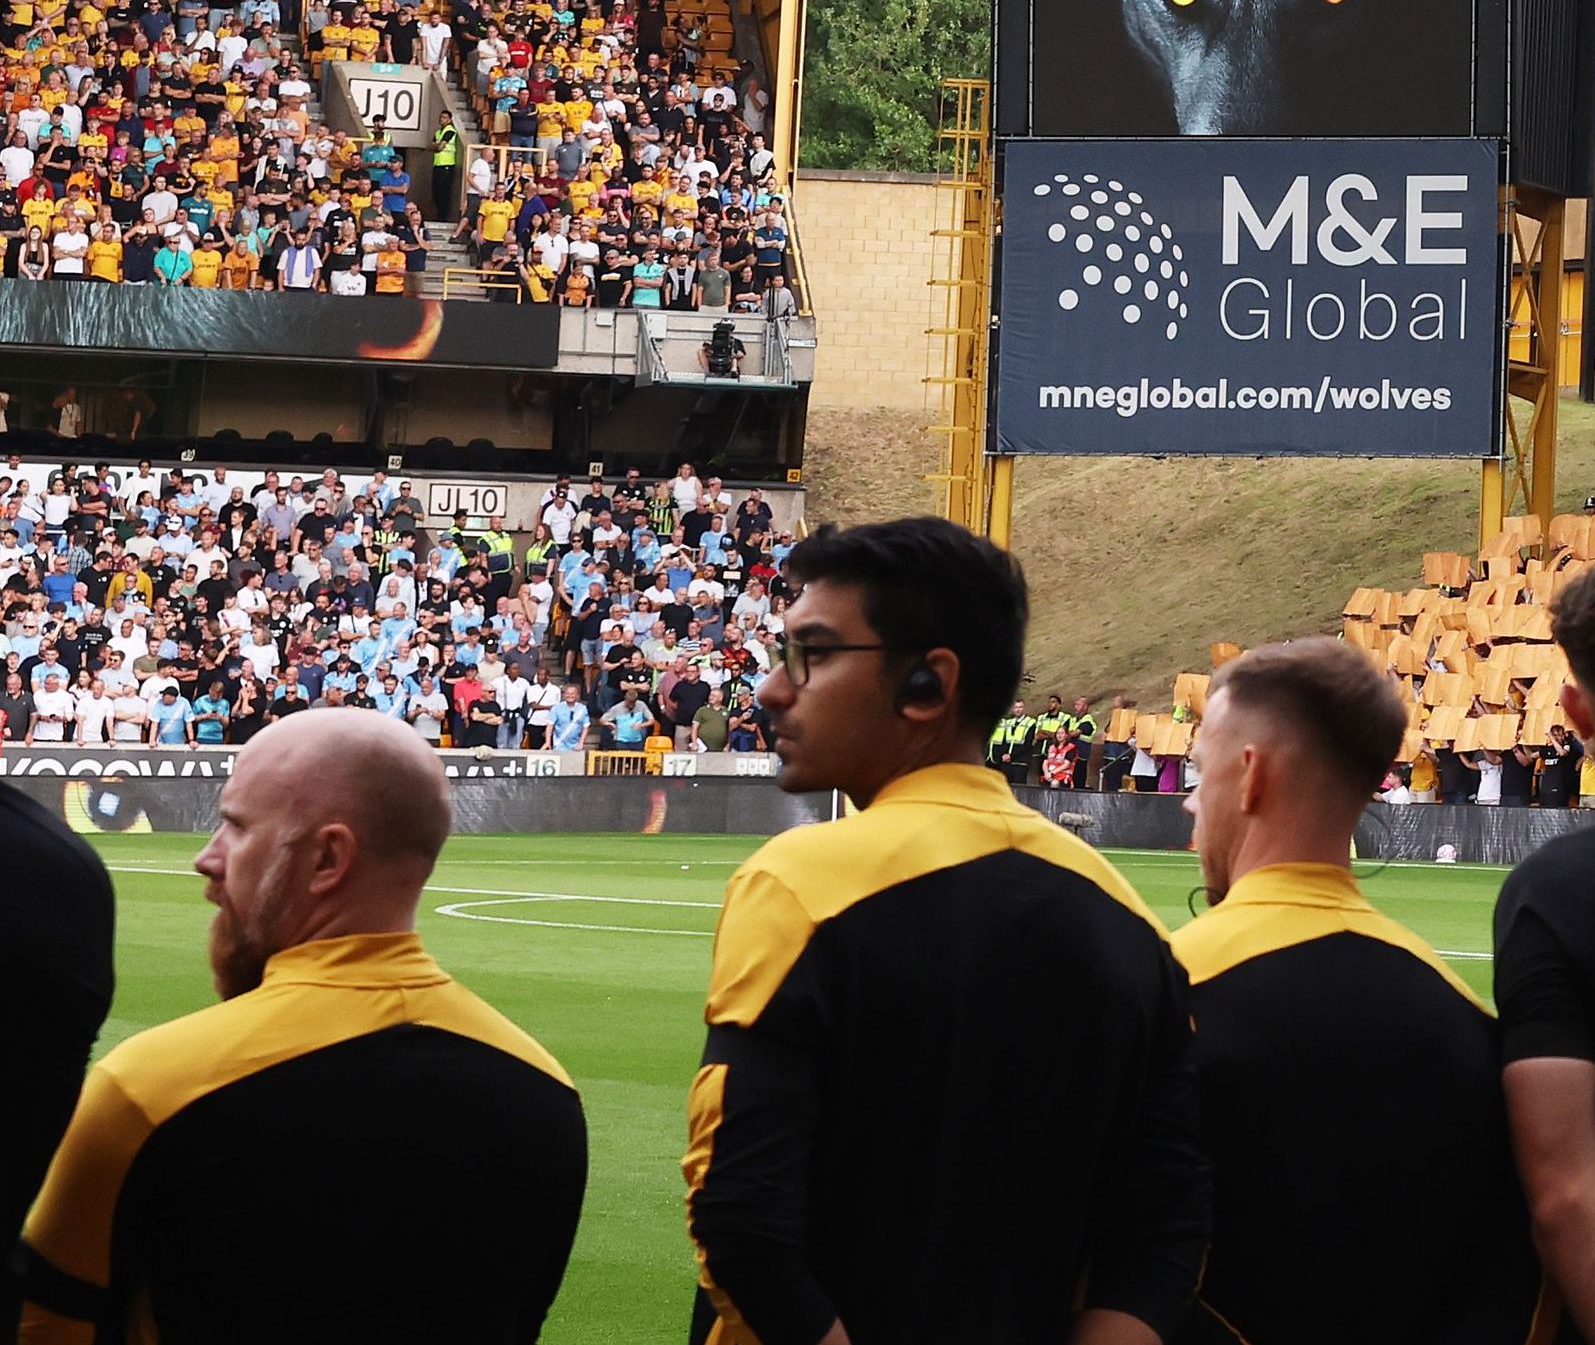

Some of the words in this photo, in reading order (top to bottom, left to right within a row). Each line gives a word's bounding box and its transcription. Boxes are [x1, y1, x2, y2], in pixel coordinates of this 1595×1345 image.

[360, 88, 414, 121] J10
[1221, 173, 1468, 266] M&E
[1219, 277, 1467, 341] Global
[1039, 376, 1452, 417] mneglobal.com/wolves
[438, 488, 498, 514] JL10
